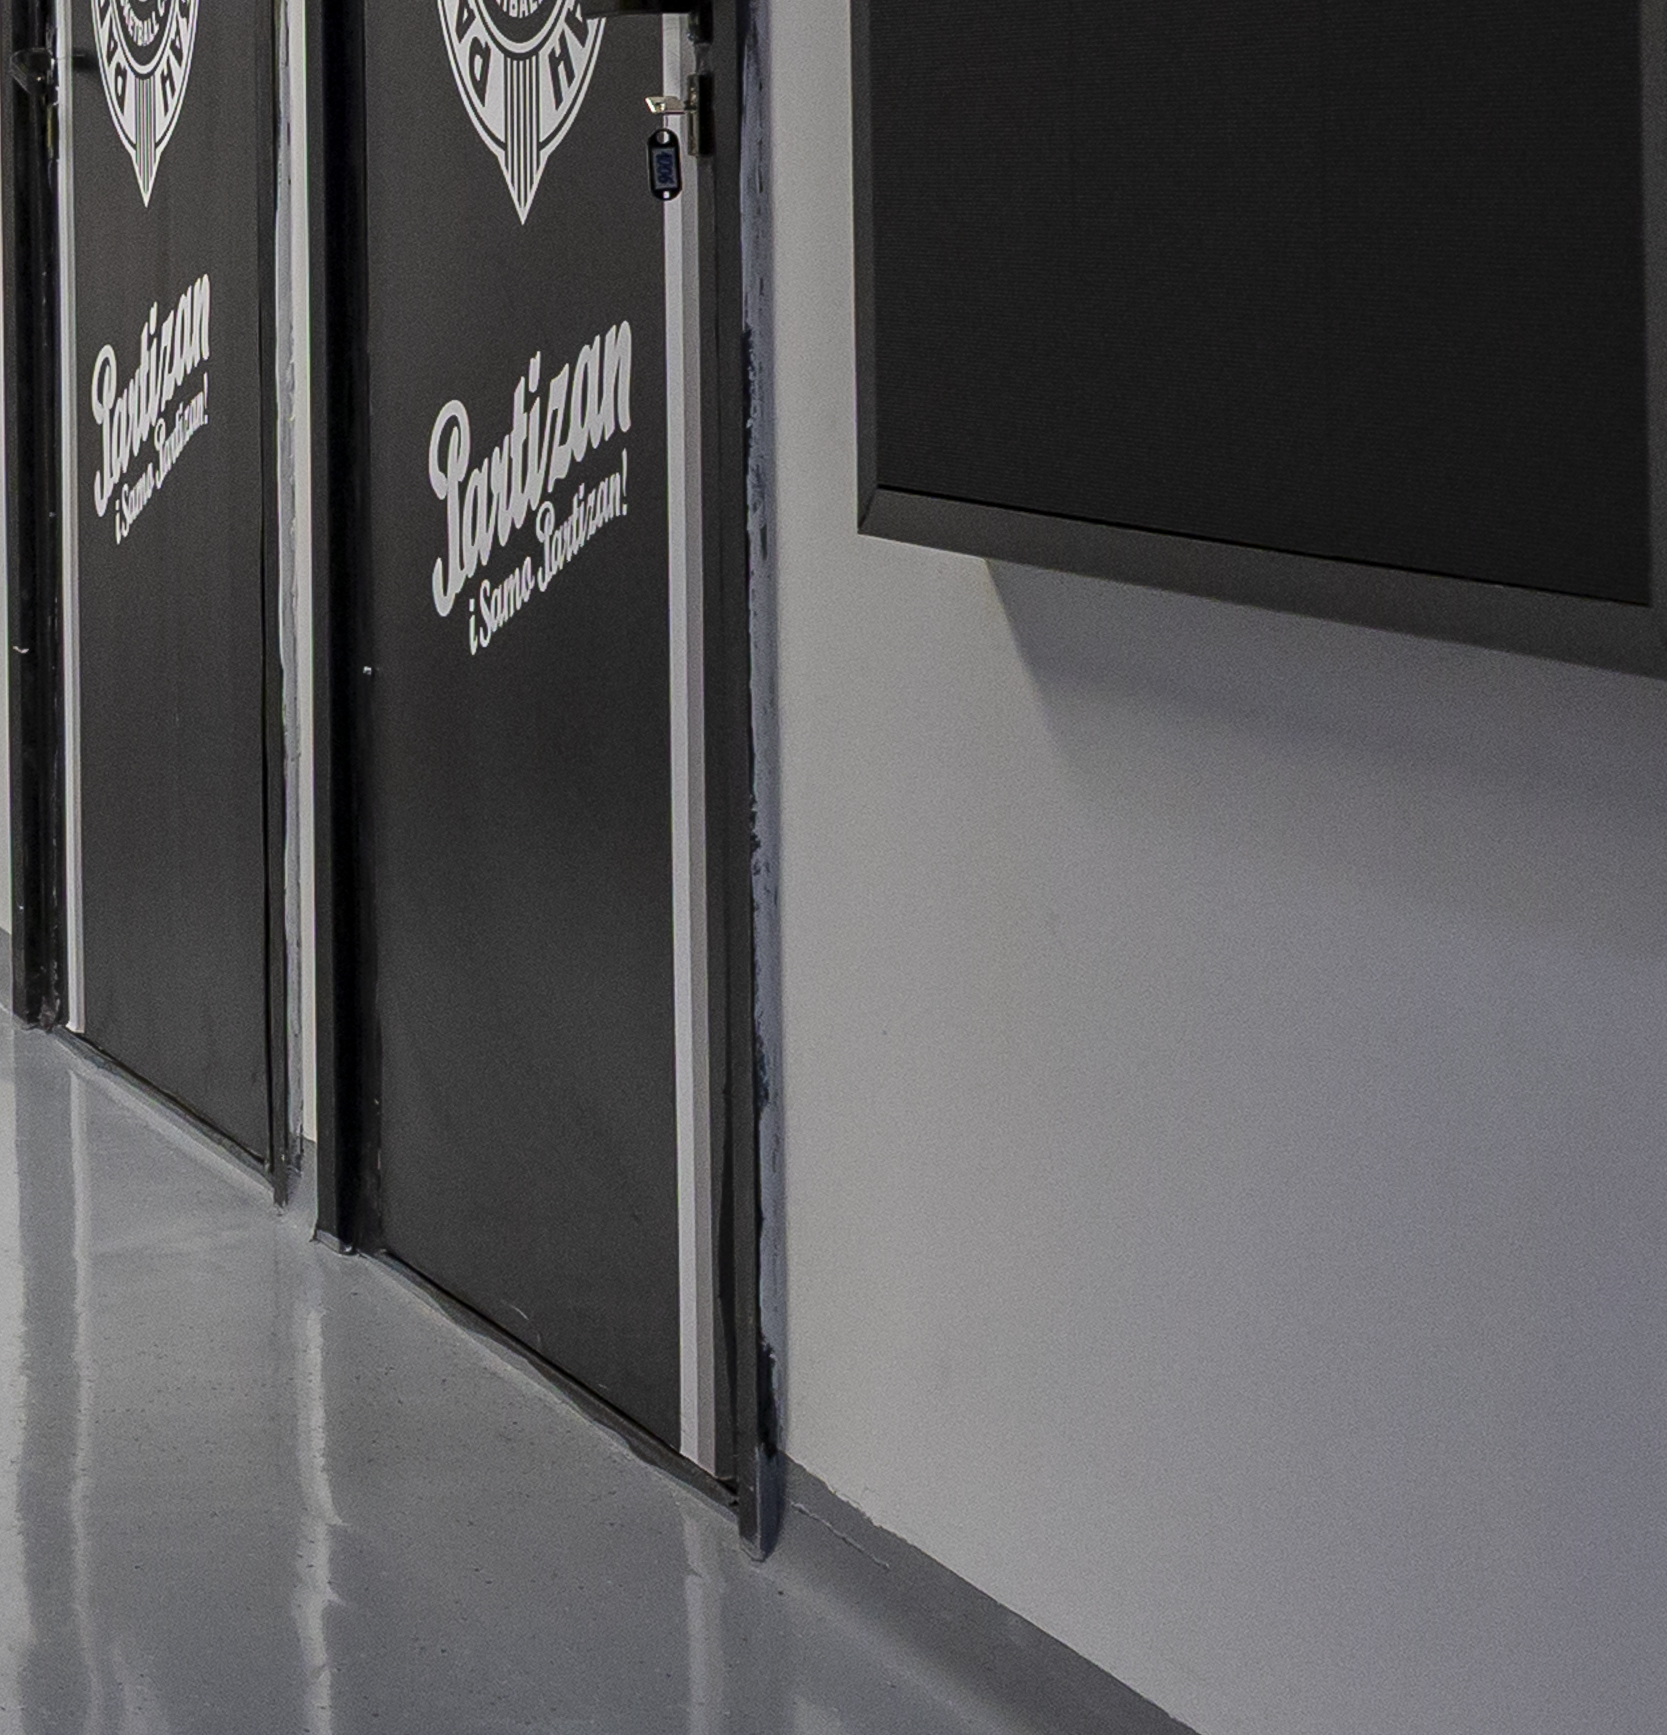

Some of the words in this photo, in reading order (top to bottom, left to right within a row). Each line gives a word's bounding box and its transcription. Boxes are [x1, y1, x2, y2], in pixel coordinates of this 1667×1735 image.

[90, 273, 210, 517] Partizan
[428, 319, 632, 617] Partizan
[536, 447, 628, 593] Partizan!
